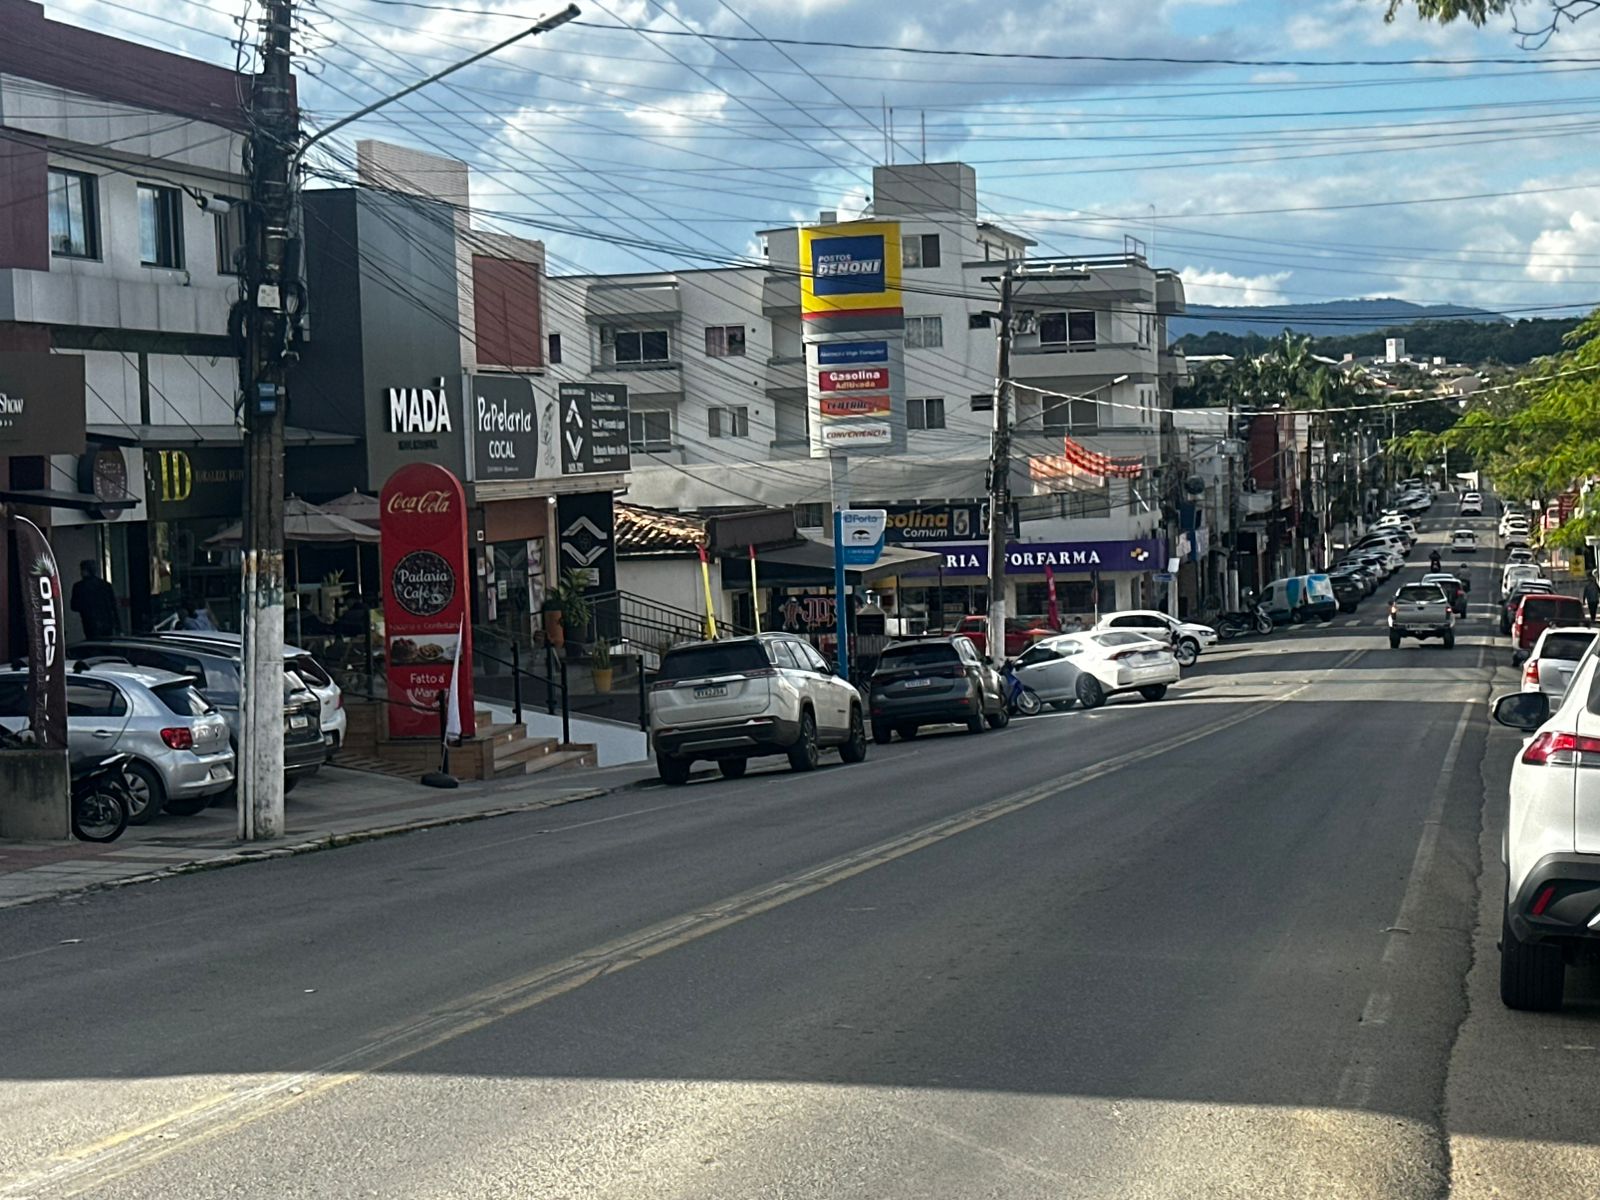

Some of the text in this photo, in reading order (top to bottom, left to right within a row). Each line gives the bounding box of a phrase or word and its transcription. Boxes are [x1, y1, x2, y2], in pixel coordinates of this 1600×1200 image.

[818, 254, 852, 263] POSTOS
[816, 259, 882, 276] DENONI
[829, 370, 881, 381] Gasolina
[389, 376, 452, 433] MADÁ
[488, 440, 516, 459] COCAL
[853, 514, 877, 523] Porto
[886, 510, 949, 528] solina
[902, 527, 948, 538] Comum
[945, 553, 980, 568] RIA
[398, 569, 448, 583] Padaria
[410, 673, 436, 684] Fatto
[414, 688, 440, 698] Man
